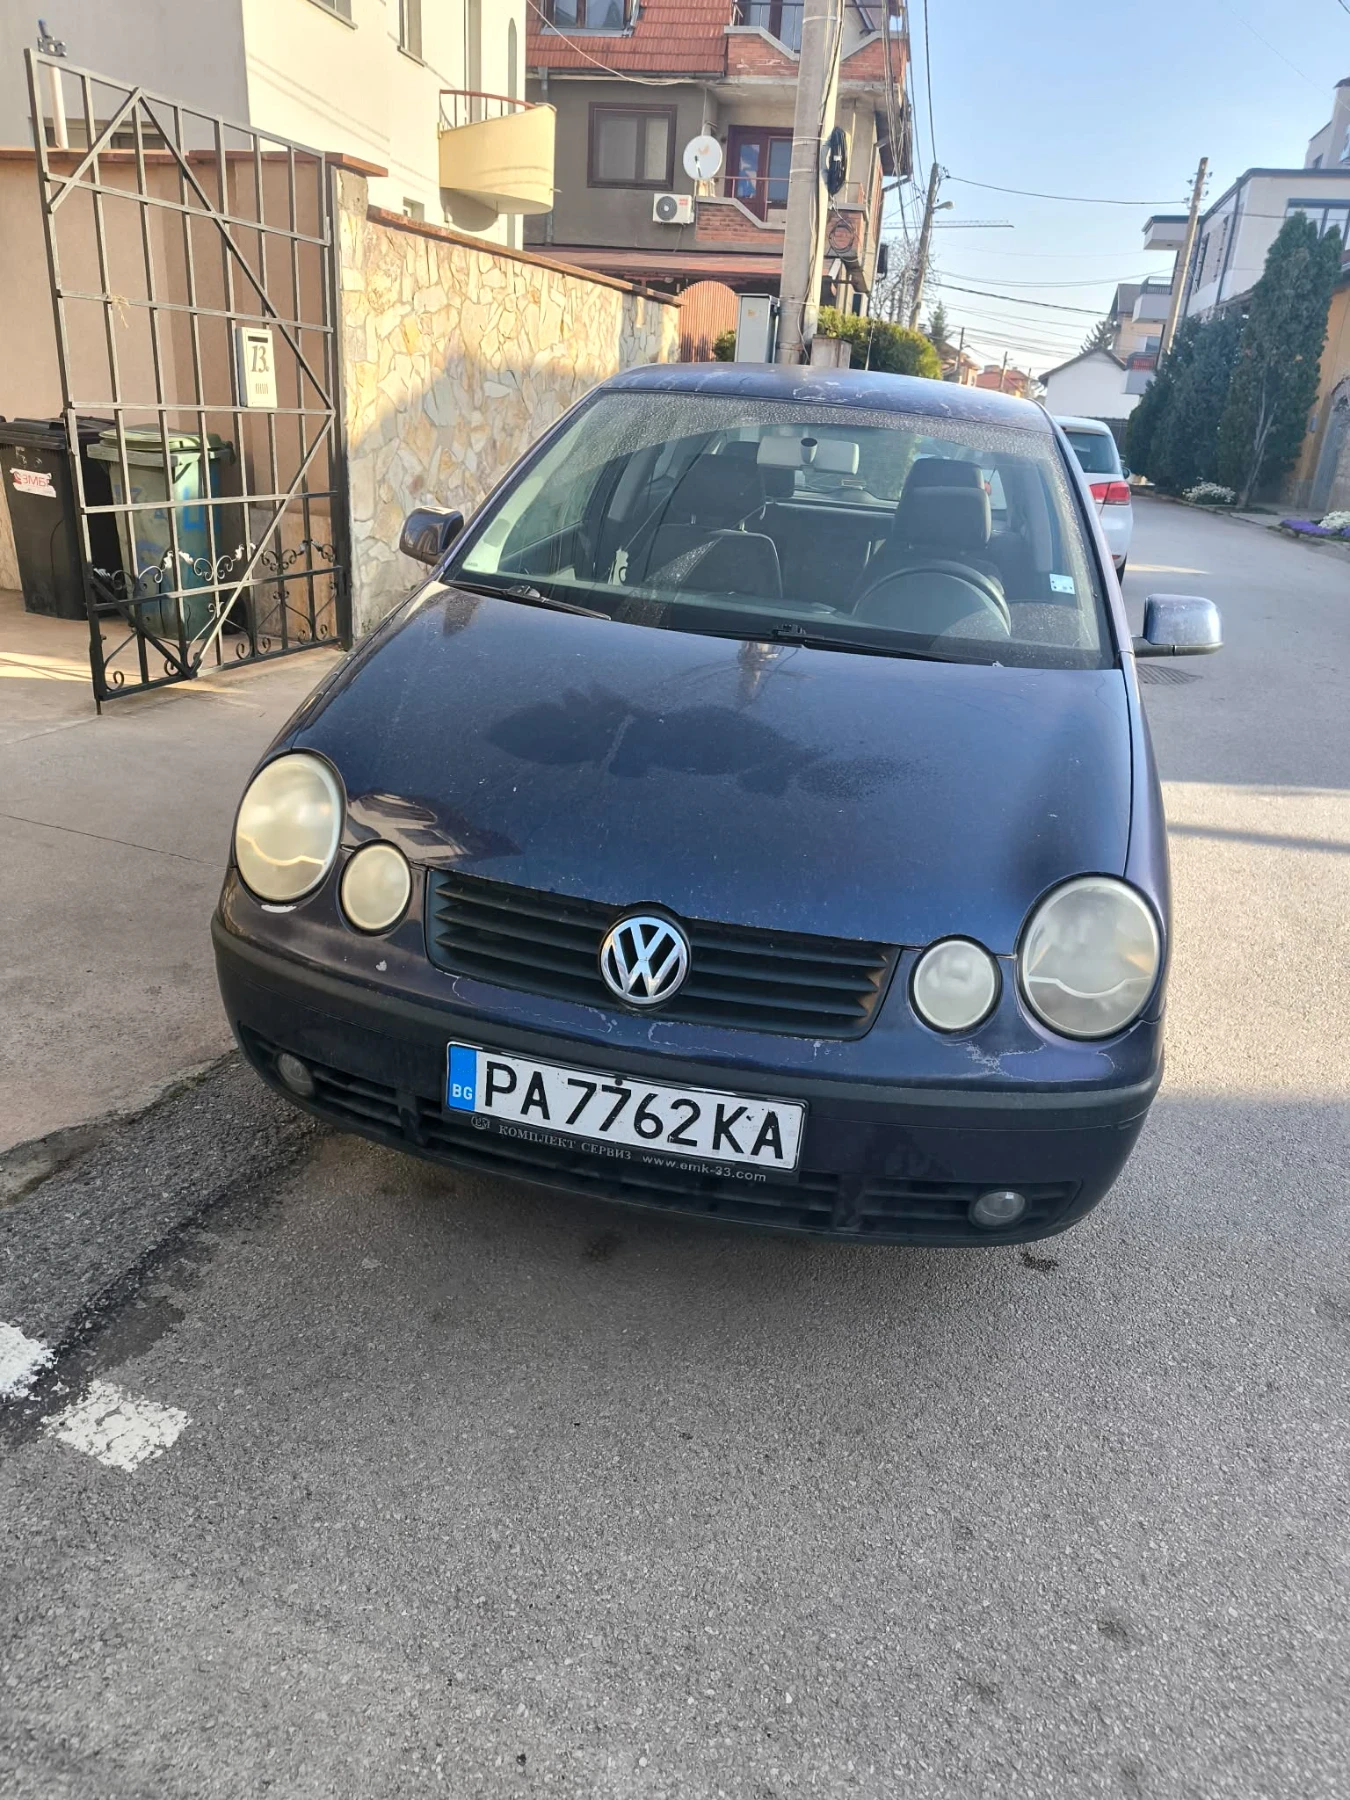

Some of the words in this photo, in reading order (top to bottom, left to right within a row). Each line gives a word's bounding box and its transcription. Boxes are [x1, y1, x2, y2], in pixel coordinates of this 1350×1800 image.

[452, 1083, 473, 1100] BG
[498, 1124, 576, 1149] КОМПЛЕКТ
[581, 1142, 632, 1160] СЕРВИЗ
[642, 1155, 767, 1182] www.emk-33.com
